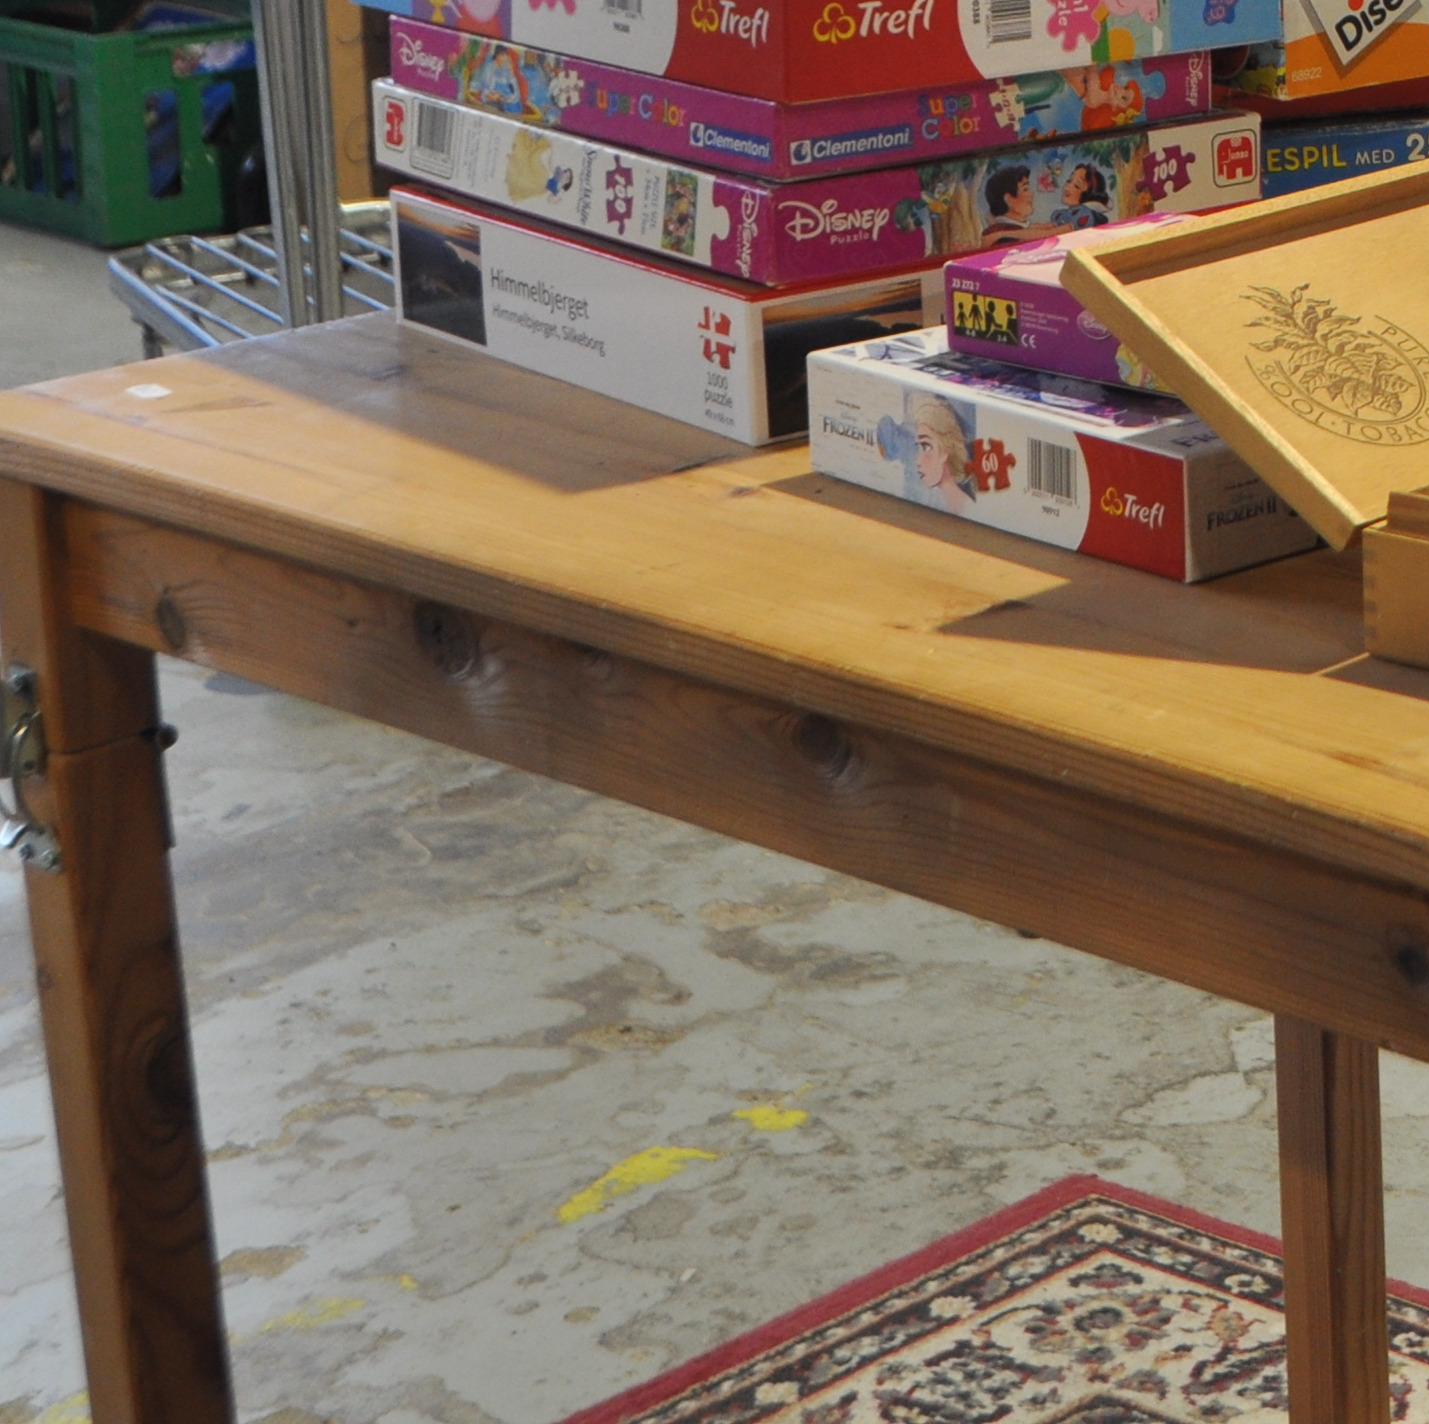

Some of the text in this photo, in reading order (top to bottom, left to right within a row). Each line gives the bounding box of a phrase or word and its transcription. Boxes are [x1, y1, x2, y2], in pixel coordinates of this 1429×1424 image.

[395, 31, 445, 78] Disney
[585, 81, 686, 127] Super Color
[917, 94, 979, 117] Super
[704, 127, 772, 159] Clementoni
[812, 128, 912, 160] Clementoni
[921, 117, 982, 141] Color
[1154, 160, 1177, 184] 100
[1354, 147, 1396, 166] MED
[736, 190, 761, 279] Disney
[777, 198, 890, 242] Disney
[829, 230, 871, 245] Puzzle
[490, 267, 590, 322] Himmelbjerget
[562, 325, 607, 358] Silkeborg
[707, 371, 729, 391] 1000
[703, 388, 734, 409] puzzle
[821, 415, 876, 447] FROZEN II
[980, 452, 999, 474] 60
[1122, 492, 1166, 531] Trefl
[1206, 496, 1278, 531] FROZEN II
